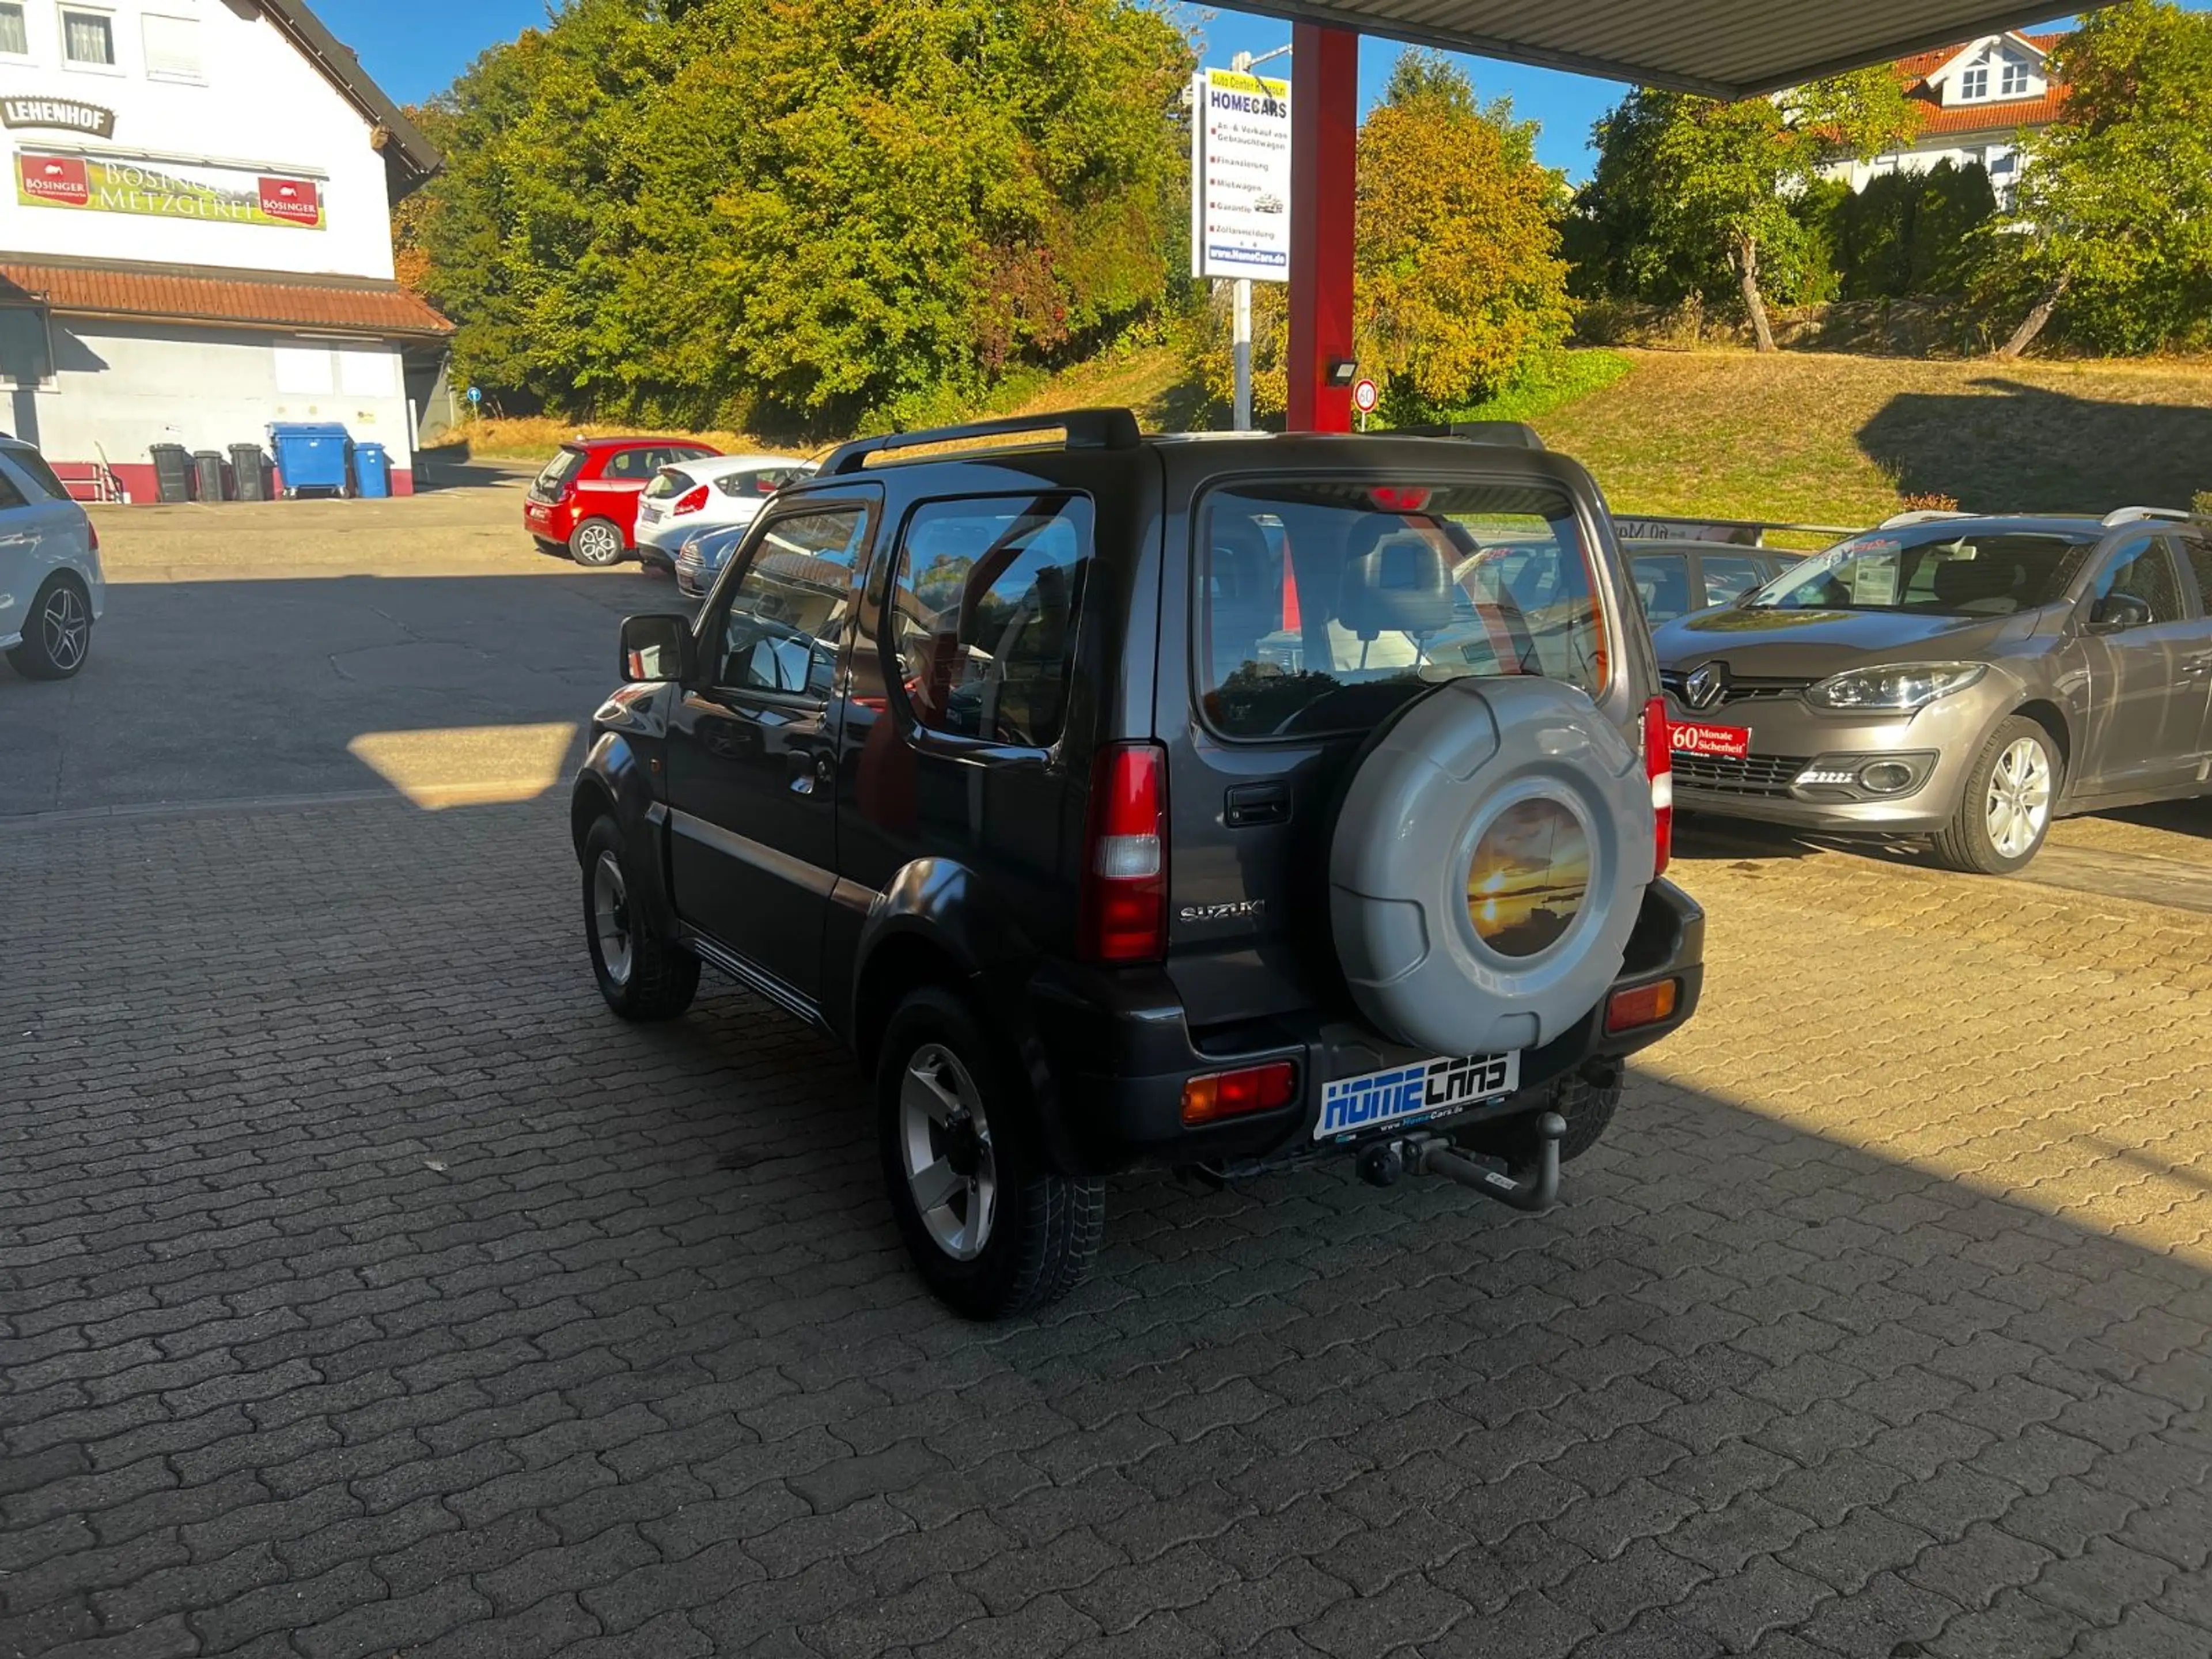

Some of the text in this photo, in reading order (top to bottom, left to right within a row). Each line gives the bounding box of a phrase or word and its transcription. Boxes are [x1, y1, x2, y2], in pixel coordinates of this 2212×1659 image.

[5, 101, 105, 130] LEHENHOF
[1211, 91, 1287, 118] HOMECARS
[1218, 133, 1286, 150] Gebrauchtwagen
[1241, 125, 1272, 137] Verkauf
[1217, 156, 1269, 172] Finanzierung
[1217, 179, 1262, 192] Mietwagen
[100, 187, 251, 219] METZGEREI
[1217, 202, 1252, 213] Garantie
[1673, 726, 1733, 748] 60 Monate
[1180, 899, 1265, 922] SUZUKI
[1325, 1052, 1508, 1130] HOMECARS
